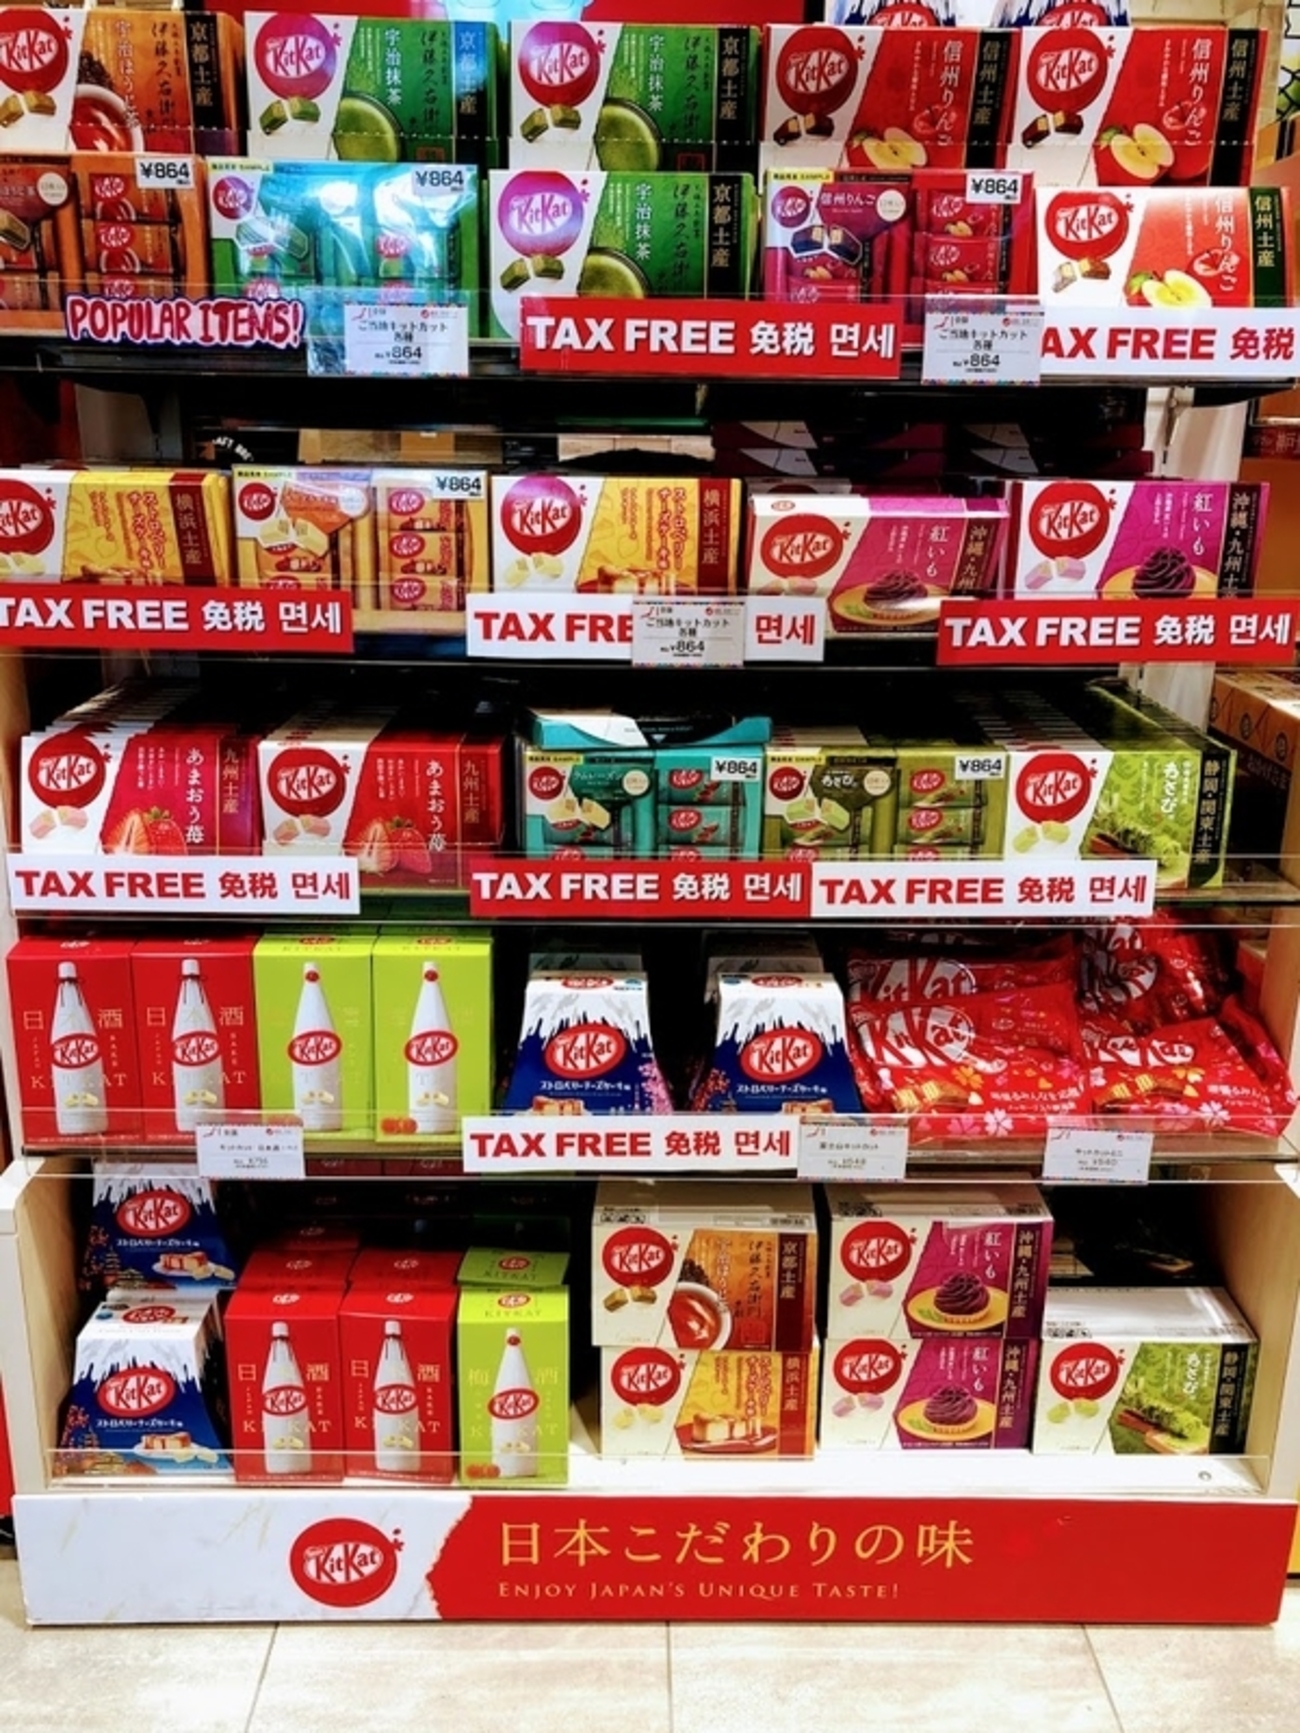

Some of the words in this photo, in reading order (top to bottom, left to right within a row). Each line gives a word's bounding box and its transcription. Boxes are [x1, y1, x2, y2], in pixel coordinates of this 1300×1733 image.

[190, 21, 213, 107] 京都土産
[268, 36, 322, 76] KitKat
[384, 28, 402, 105] 宇治抹茶
[459, 31, 478, 115] 京都土産
[536, 43, 587, 84] KitKat
[648, 35, 665, 112] 宇治抹茶
[793, 49, 845, 92] KitKat
[1042, 49, 1095, 90] KitKat
[718, 35, 739, 120] 京都土産
[935, 40, 963, 146] 信州りんご
[973, 41, 1000, 126] 信州土産
[1184, 38, 1213, 146] 信州りんご
[1222, 38, 1249, 122] 信州土産
[139, 162, 189, 179] ¥864
[415, 170, 463, 187] ¥864
[971, 178, 1018, 194] ¥864
[517, 194, 568, 232] KitKat
[635, 183, 651, 261] 宇治抹茶
[711, 184, 732, 267] 京都土産
[1063, 205, 1114, 240] KitKat
[1256, 196, 1275, 268] 信州土産
[69, 298, 192, 341] POPULAR
[201, 301, 301, 346] ITEMS!
[526, 316, 615, 351] TAX
[624, 319, 736, 355] FREE
[749, 320, 815, 356] 免税
[830, 323, 896, 359] 면세
[1041, 327, 1098, 359] AX
[1107, 328, 1218, 360] FREE
[1229, 327, 1295, 360] 免税
[435, 476, 482, 492] ¥864
[176, 493, 202, 565] 横浜土産
[519, 500, 568, 536] KitKat
[702, 488, 720, 566] 横浜土産
[1046, 501, 1096, 540] KitKat
[1191, 493, 1213, 556] 紅いも
[778, 534, 829, 563] KitKat
[928, 525, 951, 577] 紅いも
[956, 526, 988, 597] 沖縄・九州
[82, 599, 190, 631] FREE
[201, 601, 266, 632] 免税
[278, 601, 342, 634] 면세
[474, 611, 555, 642] TAX
[565, 612, 633, 642] FRE
[755, 614, 815, 646] 면세
[945, 617, 1027, 648] TAX
[1035, 616, 1141, 647] FREE
[1154, 614, 1216, 646] 免税
[1229, 613, 1292, 645] 면세
[43, 755, 92, 789] KitKat
[222, 749, 239, 814] 九州土産
[284, 766, 333, 799] KitKat
[714, 760, 758, 774] ¥864
[958, 758, 1002, 773] ¥864
[185, 748, 205, 844] あまおう苺
[426, 760, 447, 852] あまおう苺
[462, 760, 480, 824] 九州土産
[1033, 772, 1078, 804] KitKat
[15, 870, 97, 897] TAX
[104, 871, 206, 899] FREE
[218, 872, 278, 899] 免税
[292, 872, 350, 900] 면세
[472, 872, 553, 900] TAX
[560, 872, 660, 900] FREE
[672, 872, 731, 901] 免税
[743, 872, 803, 902] 면세
[818, 878, 897, 905] TAX
[905, 878, 1005, 904] FREE
[1016, 876, 1076, 904] 免税
[1089, 875, 1148, 904] 면세
[561, 1033, 612, 1070] KitKat
[758, 1037, 809, 1074] KitKat
[865, 1007, 969, 1067] KitKat
[469, 1132, 547, 1158] TAX
[556, 1131, 652, 1157] FREE
[664, 1130, 721, 1157] 免税
[734, 1129, 791, 1157] 면세
[132, 1198, 179, 1229] KitKat
[618, 1243, 661, 1273] KitKat
[780, 1240, 799, 1299] 京都土産
[855, 1237, 899, 1268] KitKat
[982, 1231, 1002, 1279] 紅いも
[626, 1363, 669, 1393] KitKat
[848, 1352, 891, 1382] KitKat
[971, 1346, 990, 1392] 紅いも
[1065, 1358, 1107, 1386] KitKat
[114, 1371, 163, 1408] KitKat
[314, 1543, 377, 1583] KitKat
[499, 1518, 975, 1569] 日本こだわりの味
[499, 1582, 578, 1599] ENJOY
[590, 1582, 686, 1599] JAPAN'S
[699, 1582, 801, 1599] UNIQUE
[812, 1582, 900, 1598] TASTE!
